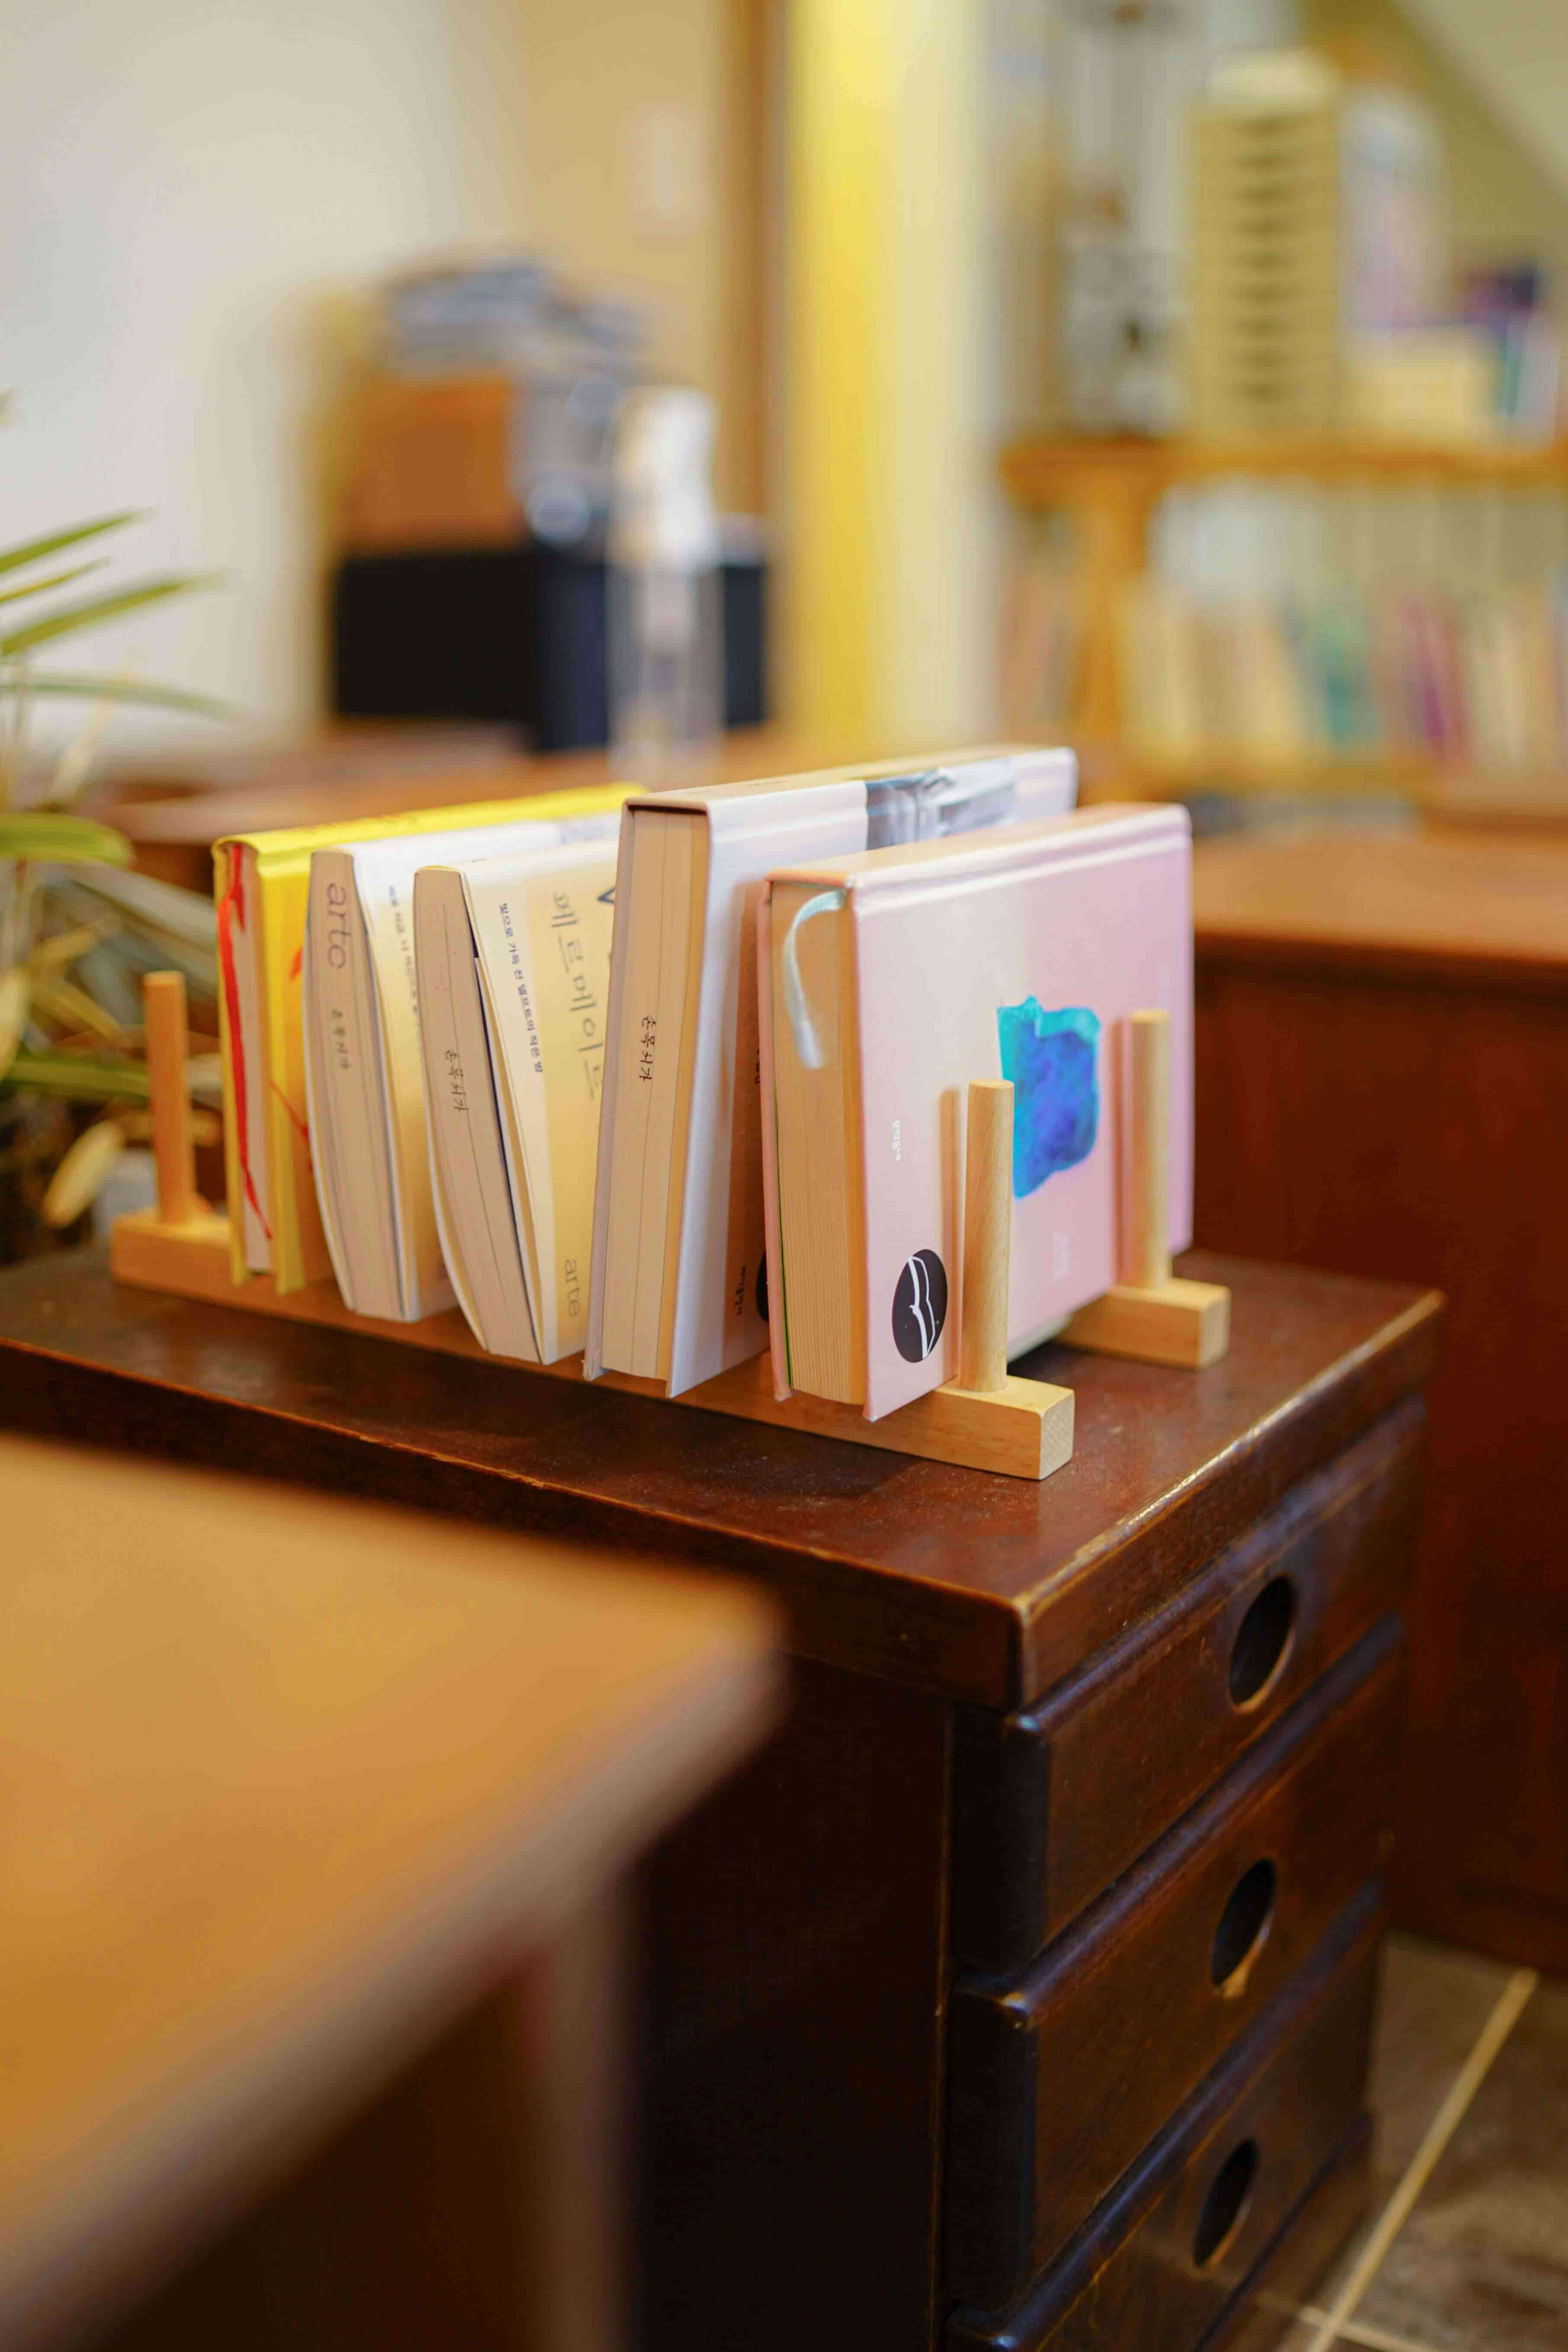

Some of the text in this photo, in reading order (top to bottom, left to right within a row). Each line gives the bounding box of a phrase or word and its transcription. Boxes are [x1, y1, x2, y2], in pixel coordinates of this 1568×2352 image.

[499, 903, 513, 938] 빛으로
[509, 941, 520, 965] 가득
[518, 984, 535, 1031] 델프트의
[530, 1034, 540, 1058] 작은
[535, 1061, 543, 1073] 방
[551, 892, 604, 1100] 페르메이르
[638, 1014, 656, 1081] 손목서가
[564, 1259, 581, 1318] arte
